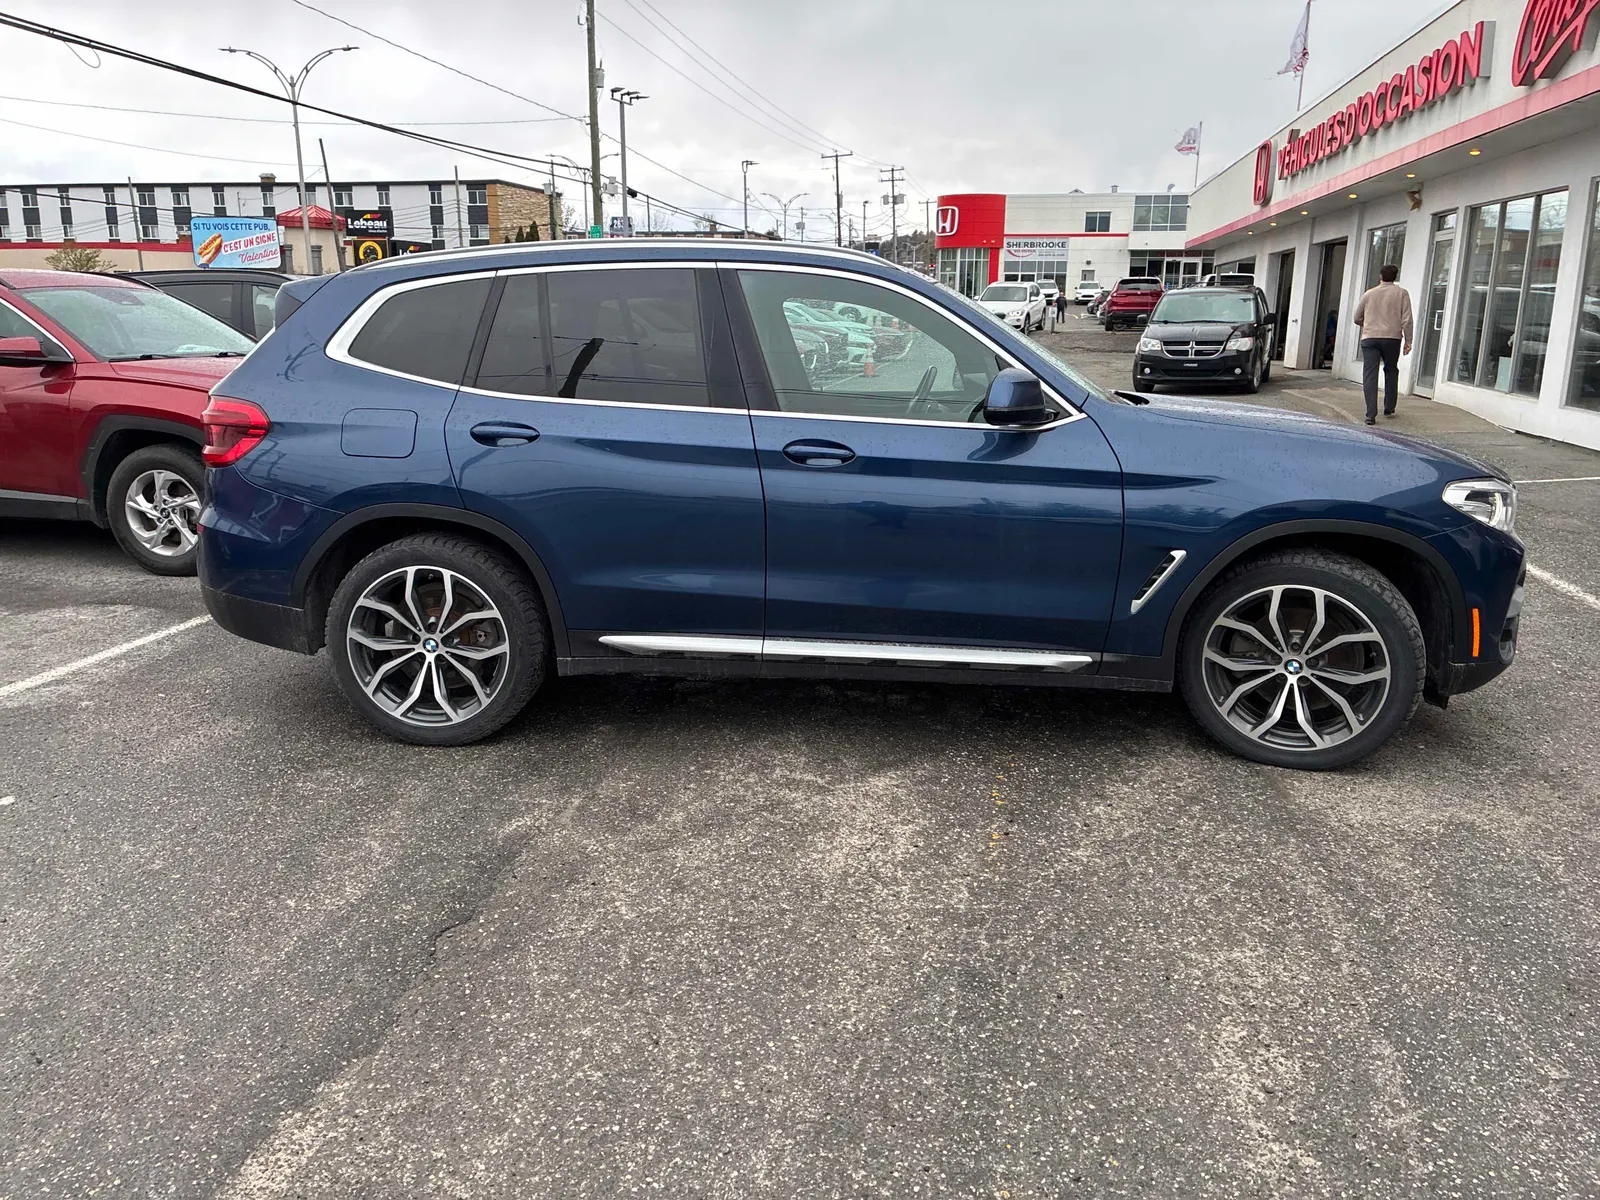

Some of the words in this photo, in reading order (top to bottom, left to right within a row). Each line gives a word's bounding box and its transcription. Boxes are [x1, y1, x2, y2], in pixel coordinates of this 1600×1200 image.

[1278, 110, 1344, 180] VÉHICULES
[1343, 20, 1485, 146] D'OCCASION
[348, 218, 388, 229] Lebeau
[223, 240, 242, 253] C'EST
[243, 236, 255, 248] UN
[256, 232, 276, 245] SIGNE
[239, 248, 278, 263] Valentine
